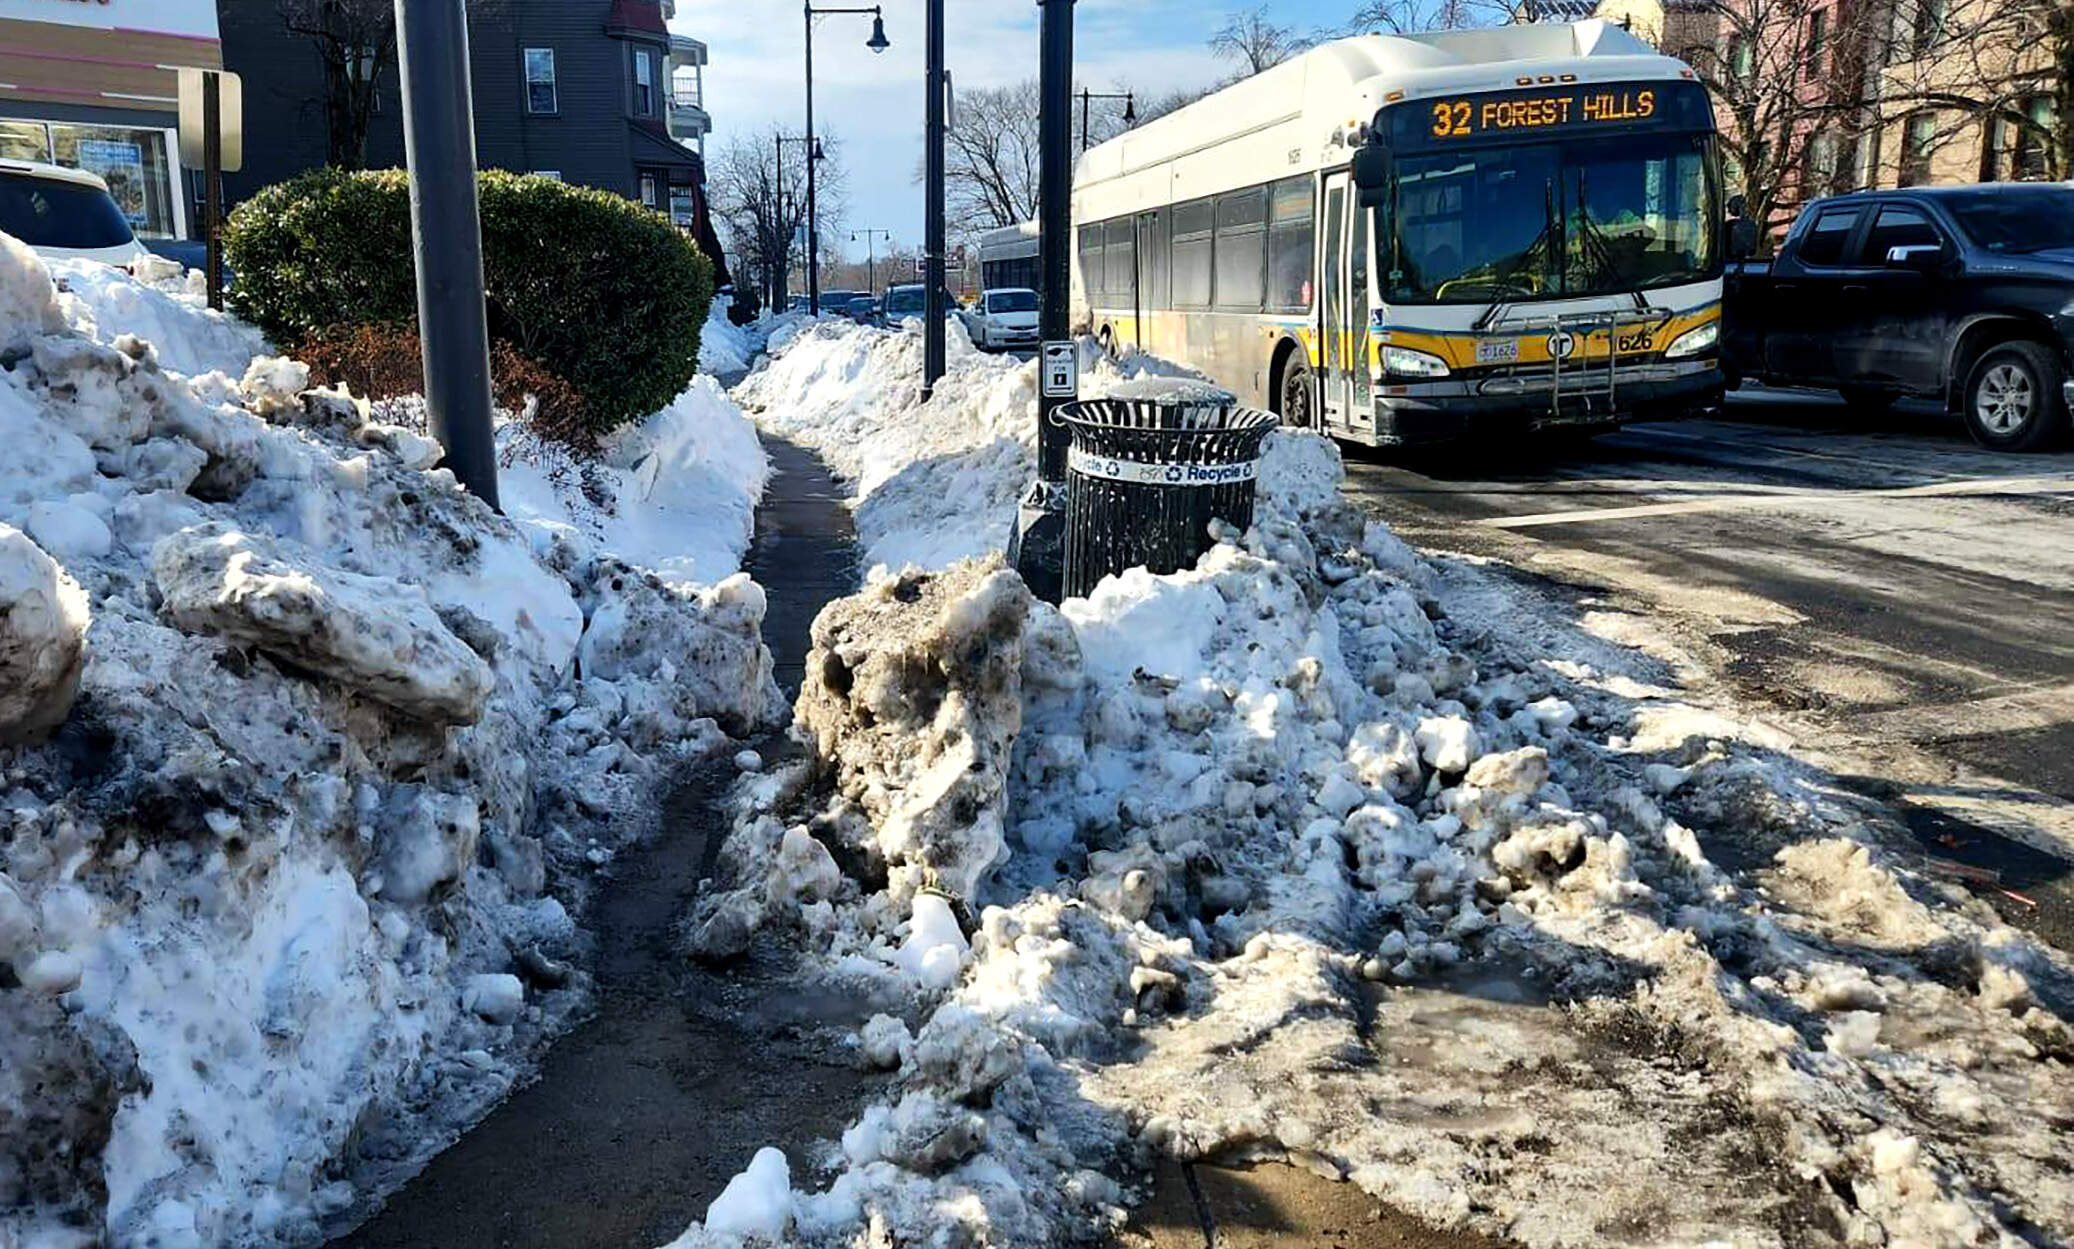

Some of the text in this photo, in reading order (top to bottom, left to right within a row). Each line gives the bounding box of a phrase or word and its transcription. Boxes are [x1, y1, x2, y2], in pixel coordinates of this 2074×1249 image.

[1432, 90, 1655, 136] 32 FOREST HILLS
[1187, 464, 1241, 483] Recycle
